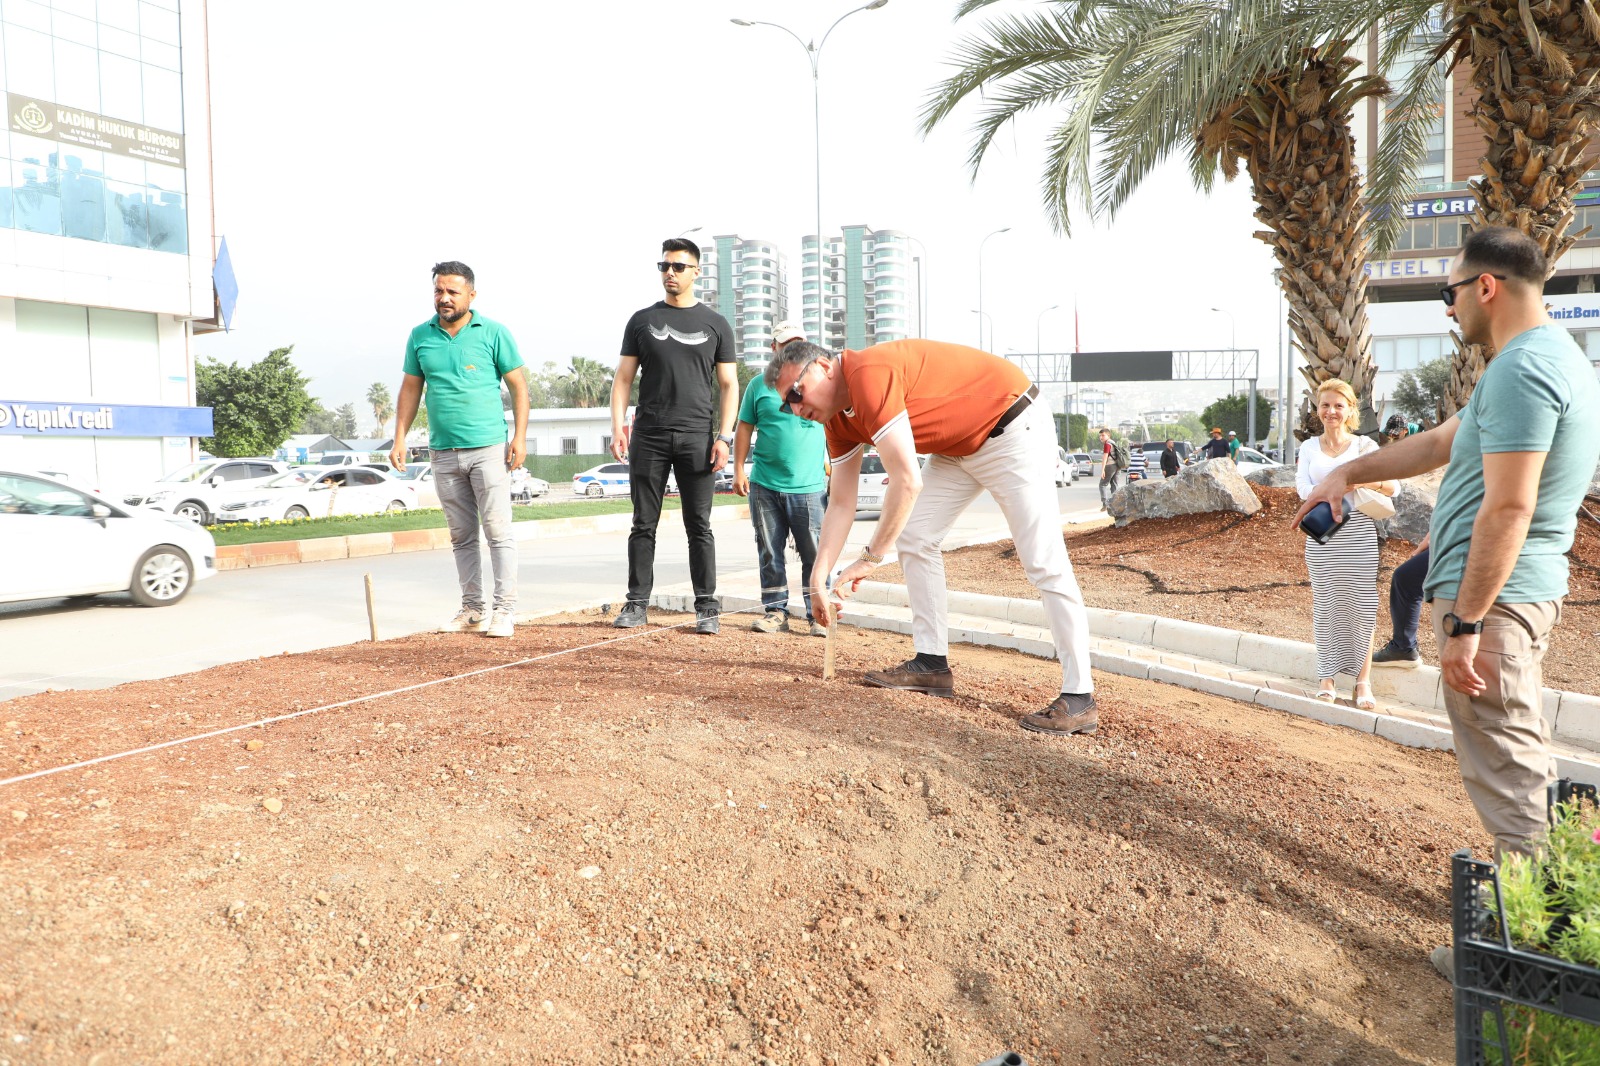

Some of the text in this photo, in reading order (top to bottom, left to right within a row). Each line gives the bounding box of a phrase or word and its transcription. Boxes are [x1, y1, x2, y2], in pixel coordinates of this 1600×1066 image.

[57, 109, 95, 130] KADİM
[98, 119, 136, 140] HUKUK
[137, 128, 180, 149] BÜROSU
[1363, 260, 1428, 277] STEEL
